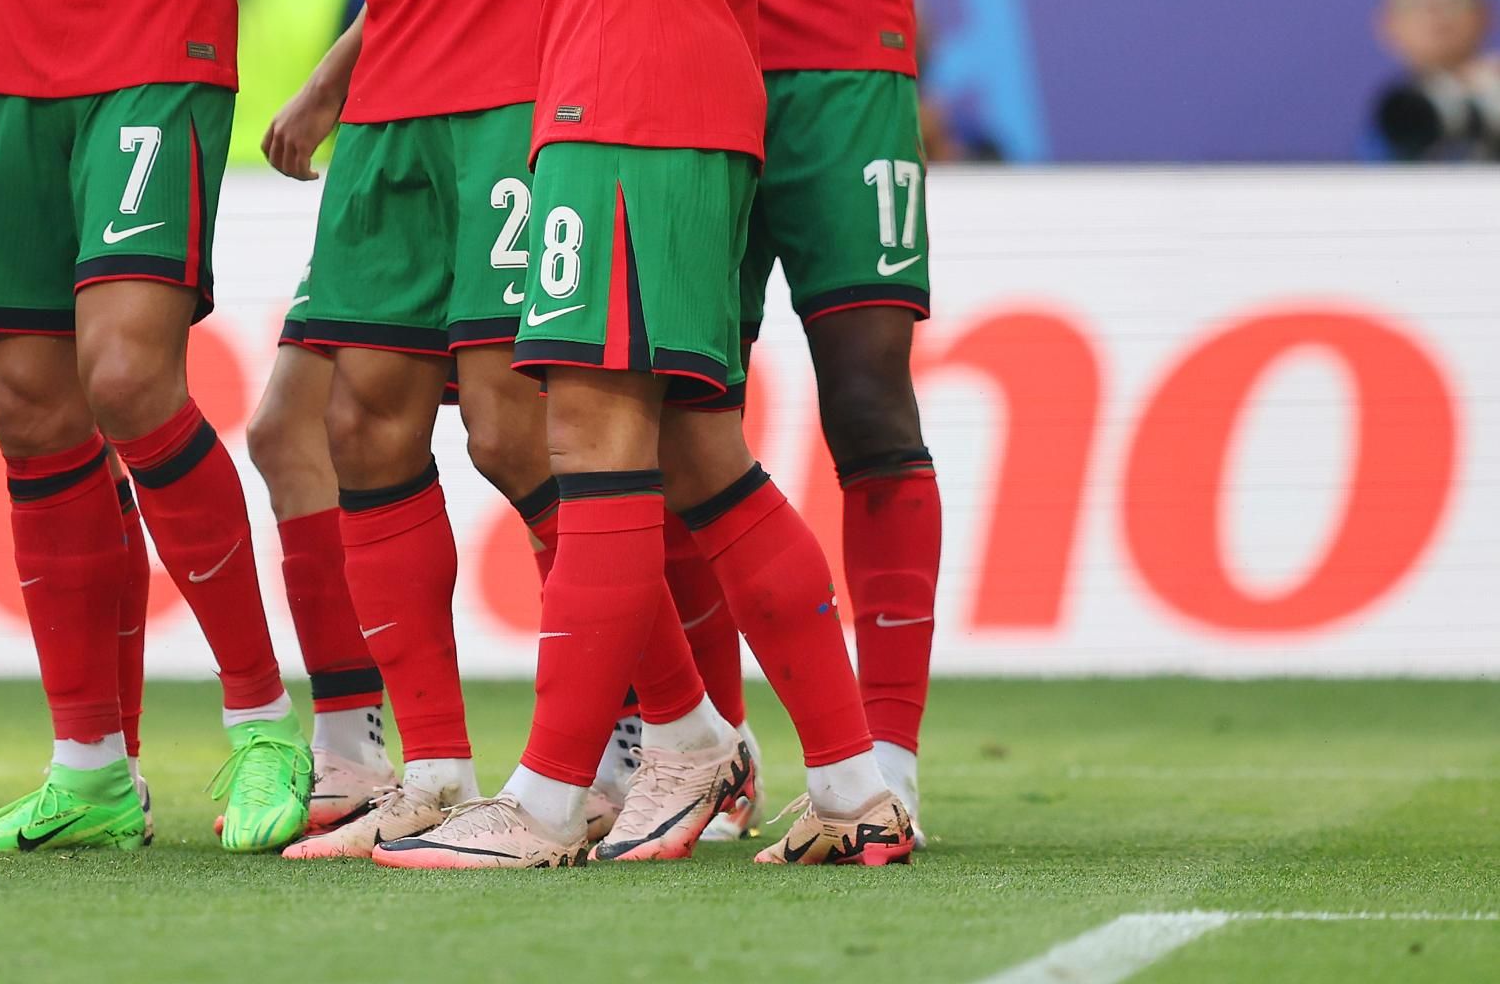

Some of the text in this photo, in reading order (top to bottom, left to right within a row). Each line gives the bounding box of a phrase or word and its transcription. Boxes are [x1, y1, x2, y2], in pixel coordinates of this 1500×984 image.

[119, 126, 162, 214] 7
[863, 159, 921, 248] 17
[490, 178, 532, 269] 2
[540, 206, 584, 299] 8
